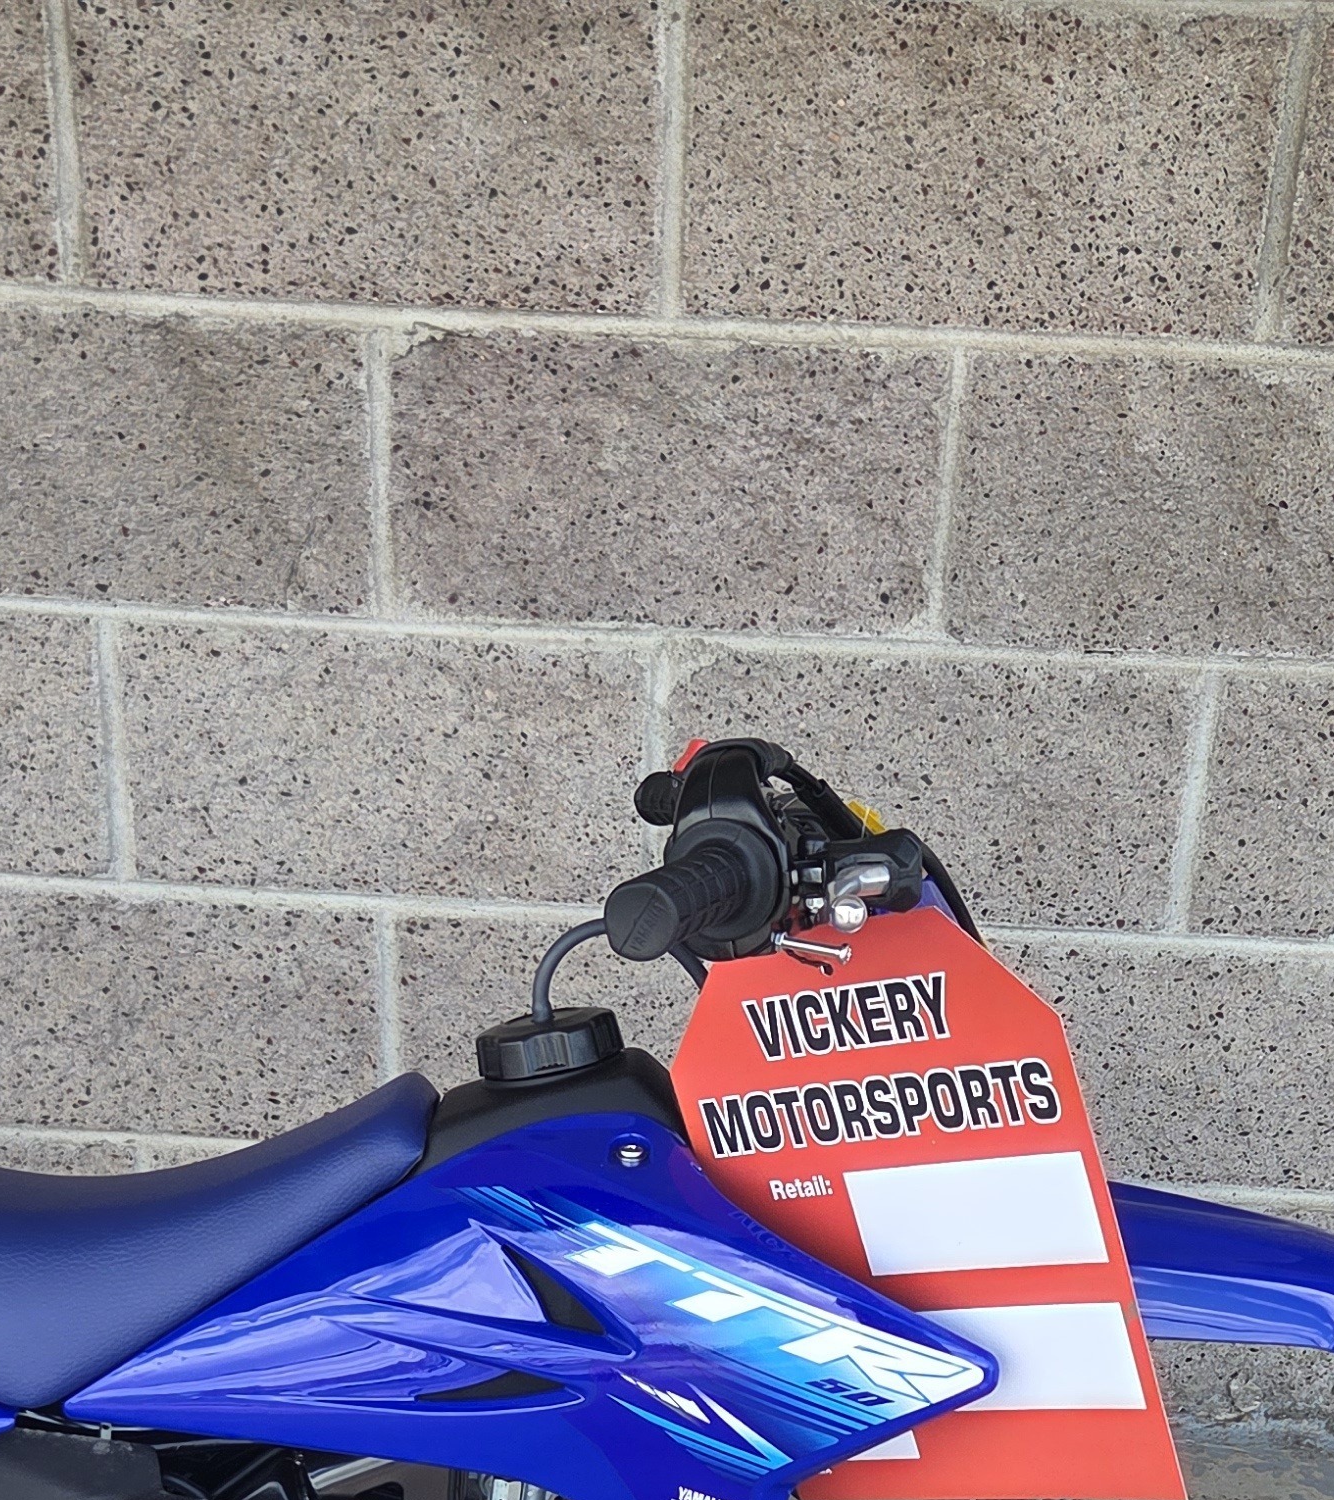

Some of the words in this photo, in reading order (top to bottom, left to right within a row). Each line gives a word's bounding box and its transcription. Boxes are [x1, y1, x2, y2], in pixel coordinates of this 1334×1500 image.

[744, 972, 950, 1061] VICKERY
[700, 1059, 1060, 1157] MOTORSPORTS
[769, 1174, 833, 1201] Retail:
[805, 1378, 895, 1406] 50
